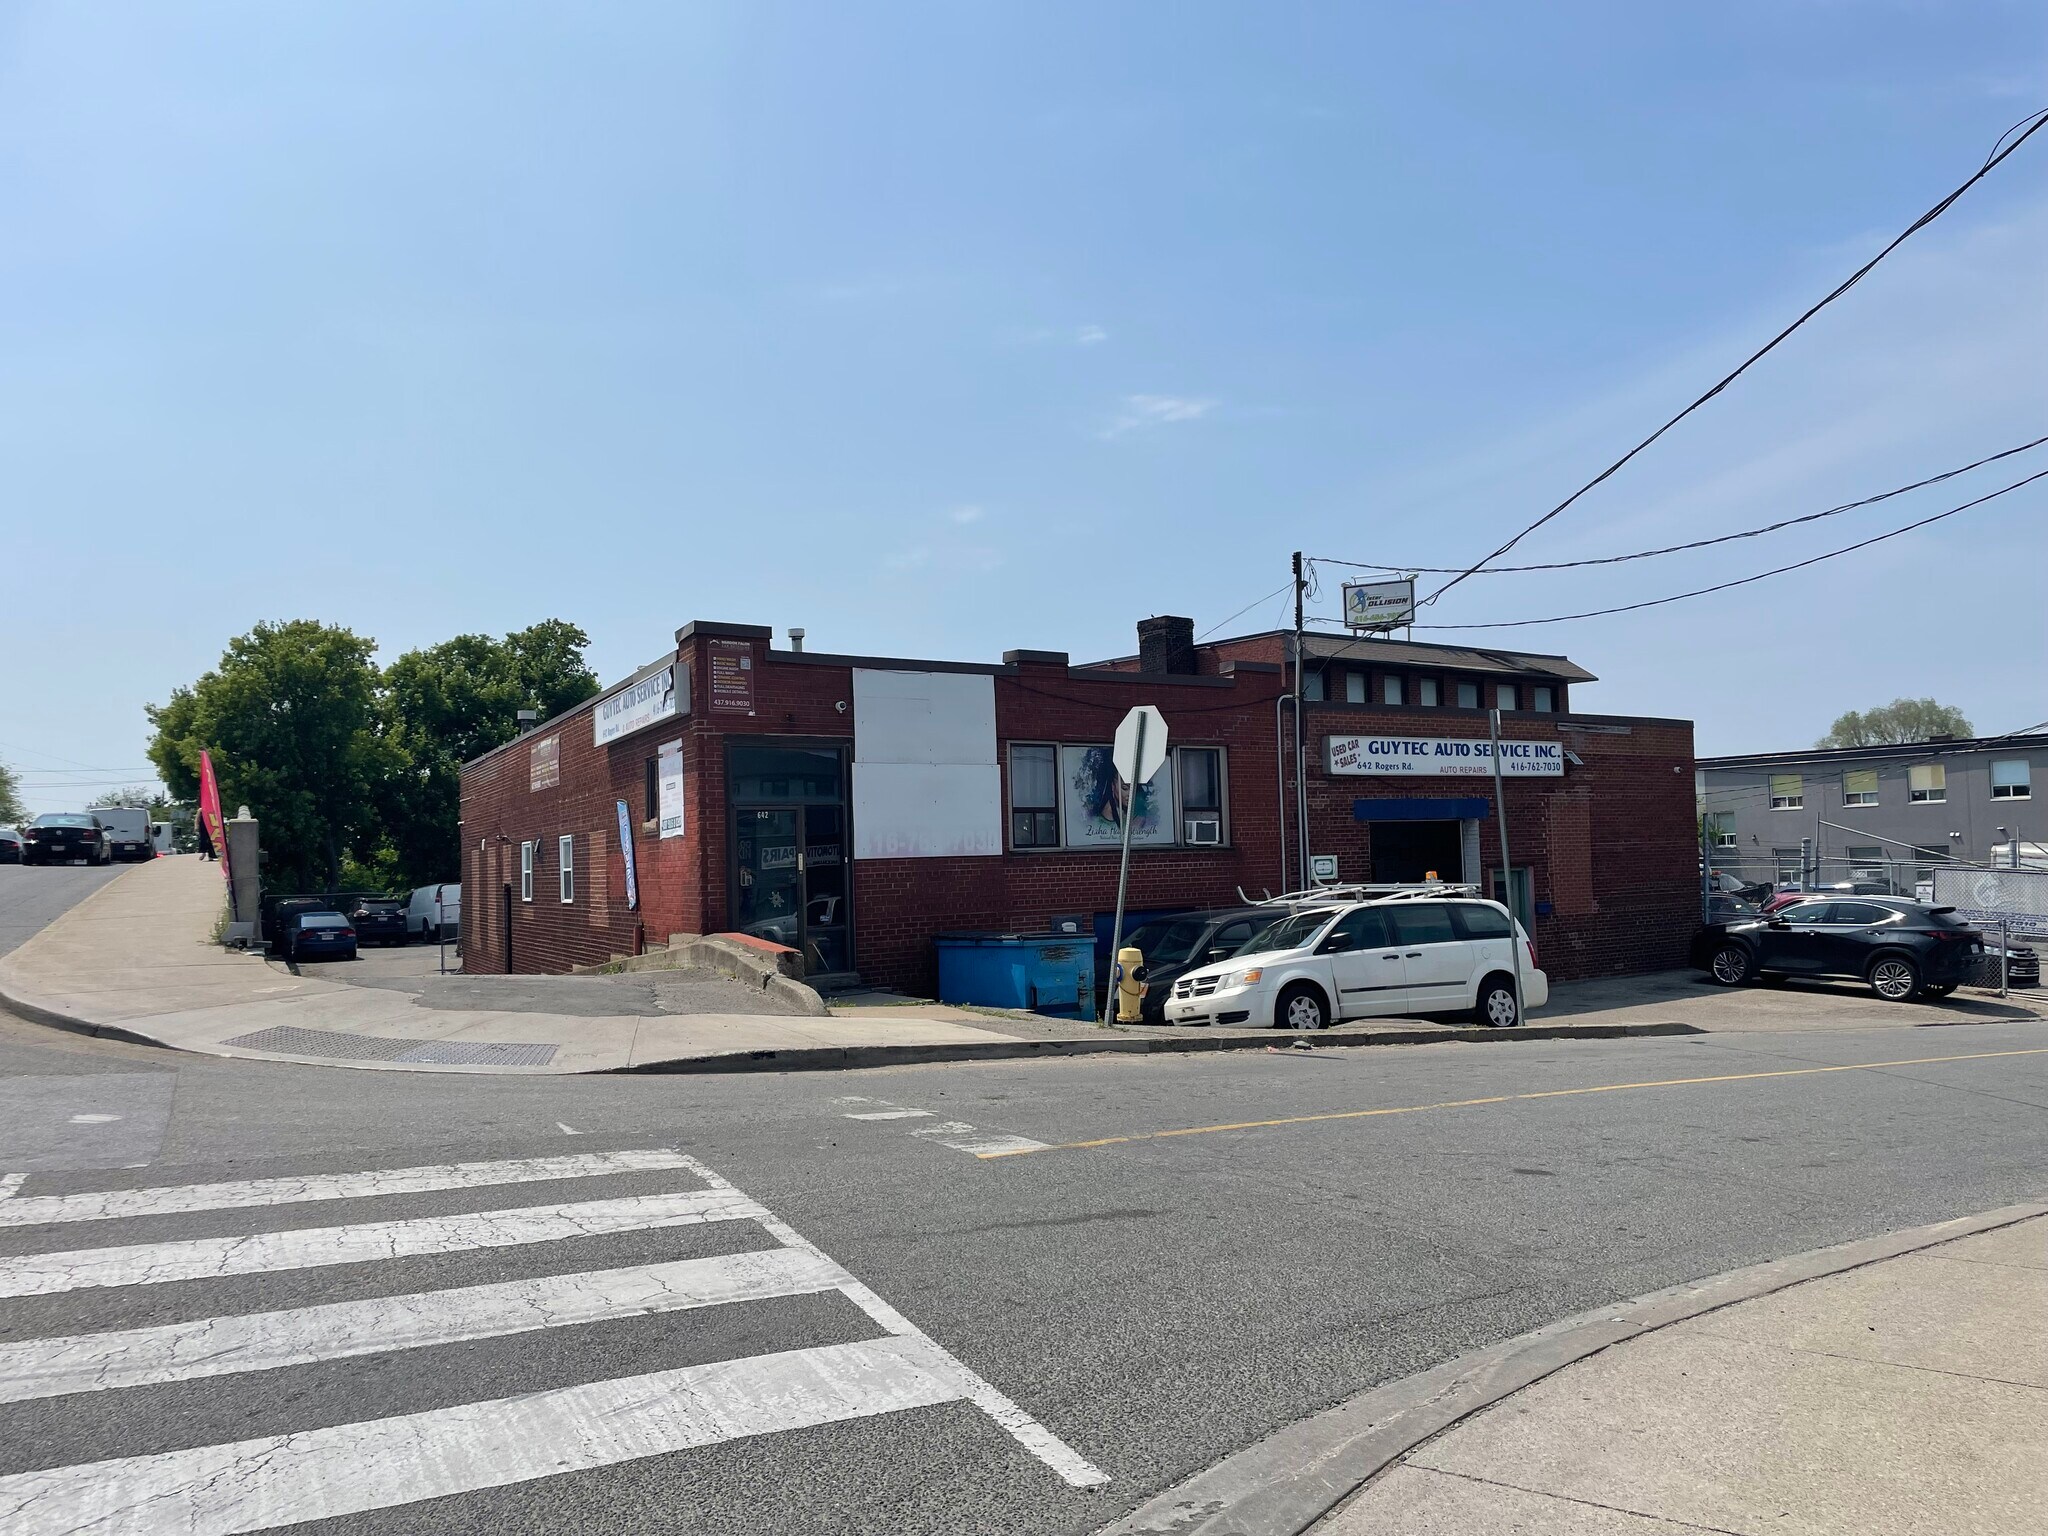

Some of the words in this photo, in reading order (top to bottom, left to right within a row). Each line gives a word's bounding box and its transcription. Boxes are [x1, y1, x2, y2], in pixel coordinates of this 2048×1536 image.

[623, 690, 636, 711] AUTO
[637, 677, 660, 704] SERVICE
[713, 699, 751, 707] 437.916.9030
[1331, 743, 1347, 757] USED
[1347, 739, 1360, 751] CAR
[1368, 740, 1429, 755] GUYTEC
[1434, 742, 1472, 757] AUTO
[1535, 745, 1561, 758] INC.
[1340, 753, 1358, 768] SALES
[1357, 761, 1372, 770] 642
[1375, 762, 1400, 772] Rogers
[1402, 762, 1414, 770] Rd.
[1439, 766, 1458, 774] AUTO
[1460, 766, 1487, 774] REPAIRS
[1510, 762, 1561, 772] 416-762-7030
[757, 811, 769, 819] 642
